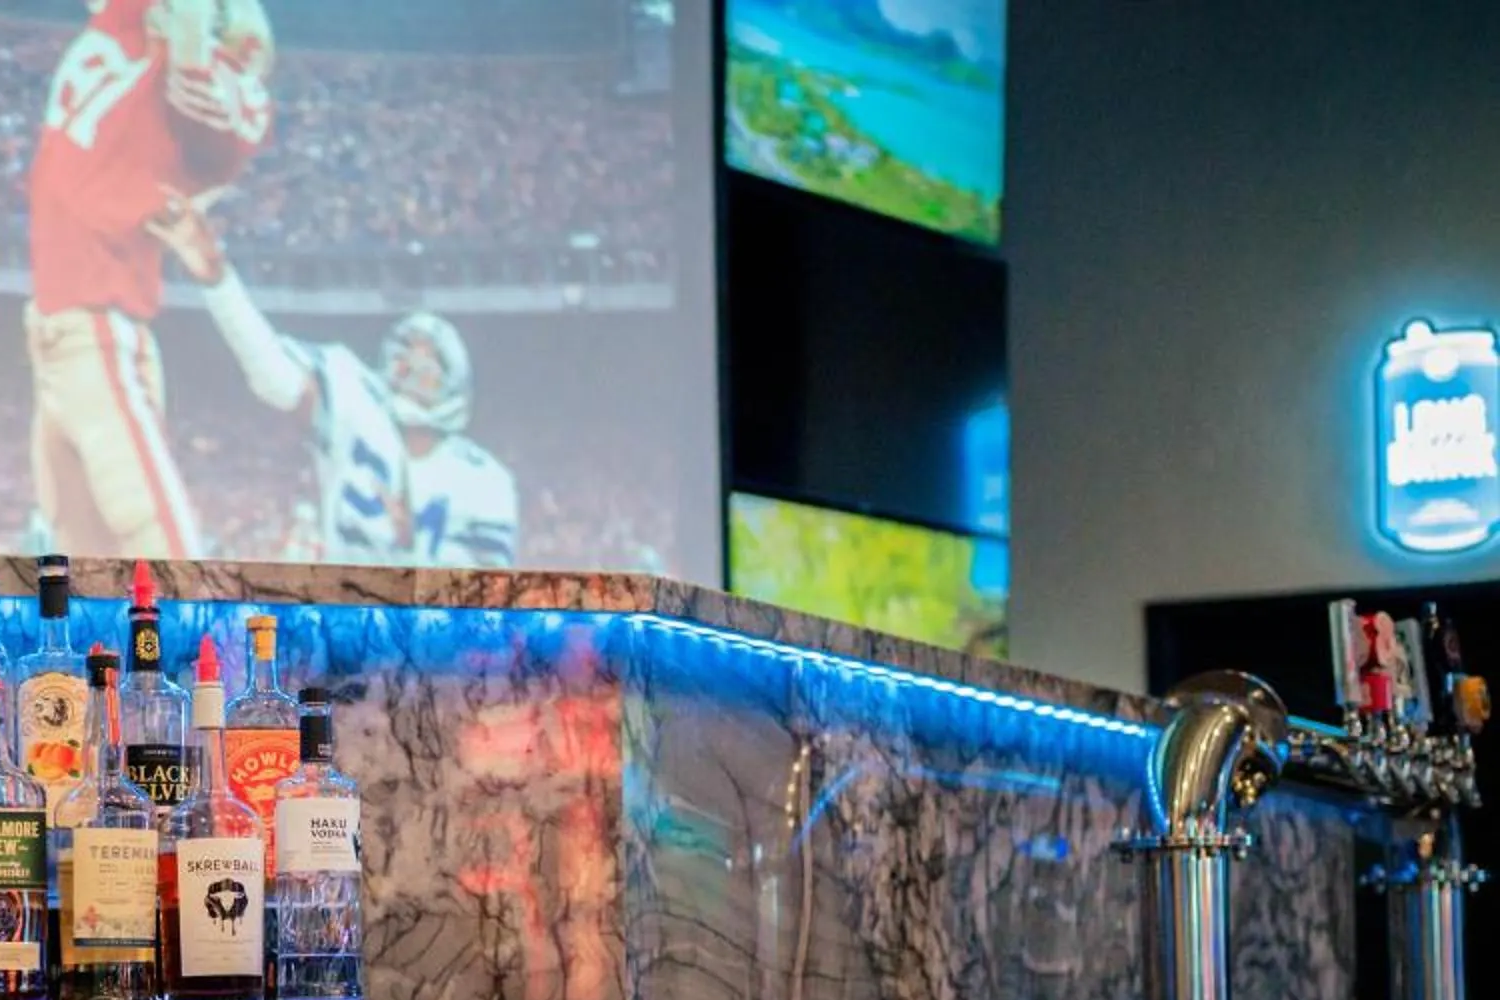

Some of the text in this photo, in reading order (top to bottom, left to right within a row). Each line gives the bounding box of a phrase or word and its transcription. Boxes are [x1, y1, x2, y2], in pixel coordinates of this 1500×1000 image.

[128, 764, 189, 783] BLACK
[231, 752, 300, 784] HOWLE
[310, 818, 347, 829] HAKU
